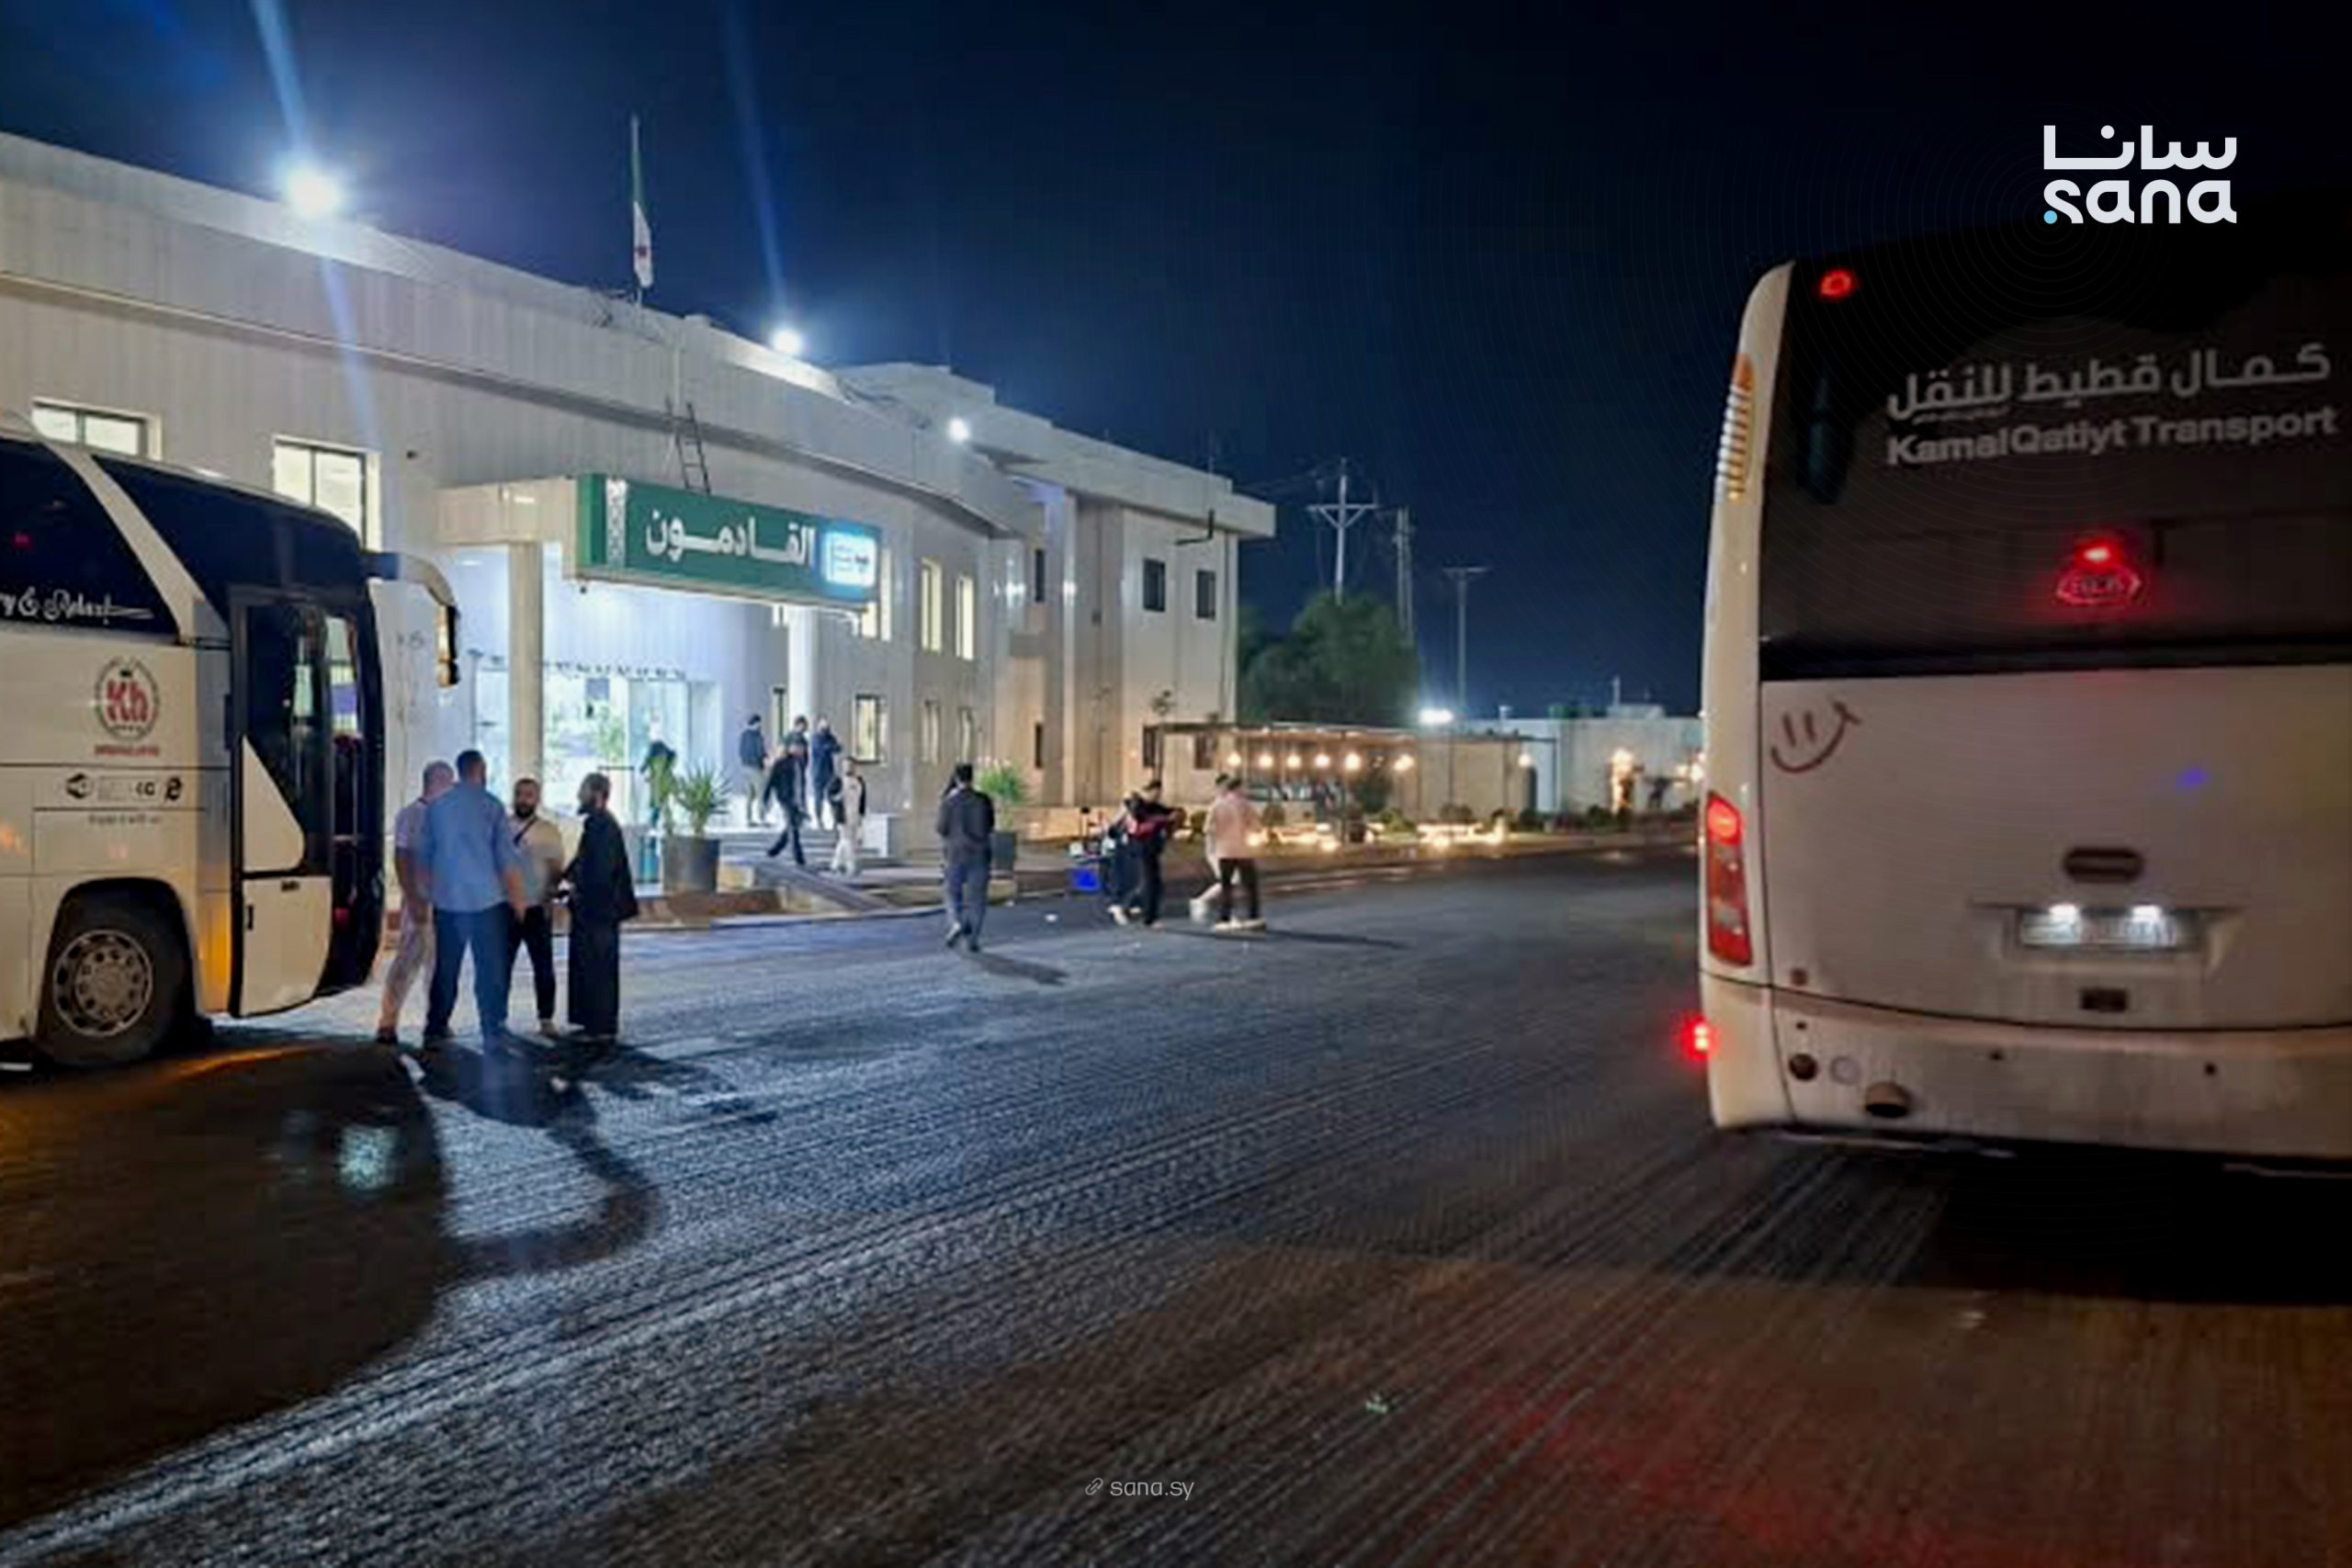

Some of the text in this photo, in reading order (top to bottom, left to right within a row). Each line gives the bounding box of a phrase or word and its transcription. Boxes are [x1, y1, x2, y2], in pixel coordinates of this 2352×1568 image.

[1887, 363, 2012, 421] للنقل
[2172, 343, 2332, 398] كمال
[1887, 426, 2007, 466] Kamal
[2131, 405, 2338, 445] Transport
[646, 510, 816, 567] القادمون
